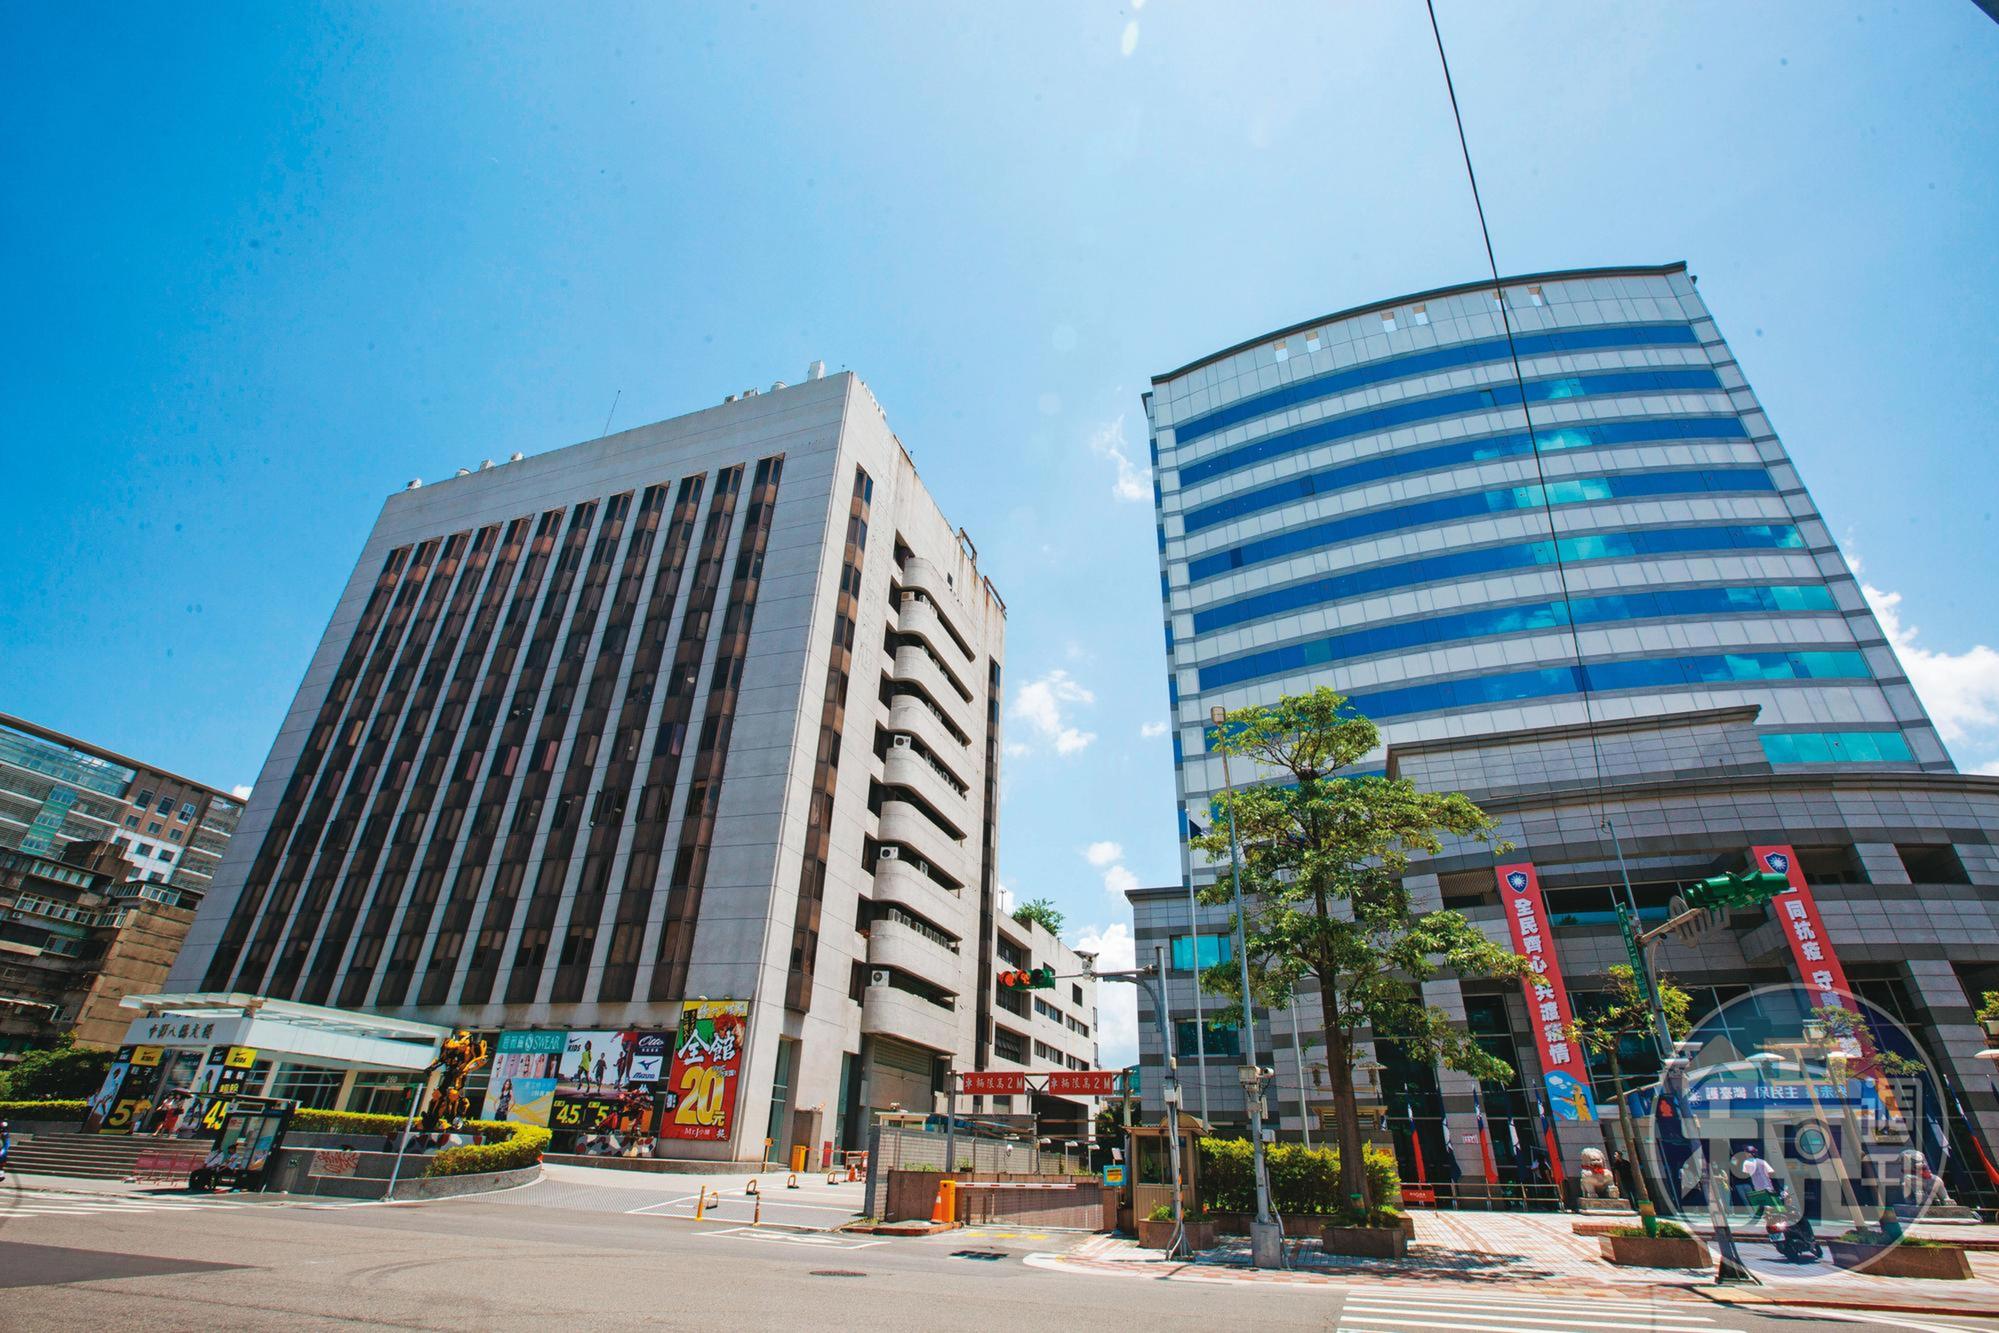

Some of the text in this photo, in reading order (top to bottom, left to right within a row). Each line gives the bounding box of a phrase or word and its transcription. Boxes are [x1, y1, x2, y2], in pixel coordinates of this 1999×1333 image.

[1513, 898, 1548, 974] 全民齊心
[532, 1035, 561, 1051] SWEAR
[567, 1044, 582, 1053] KIDS
[678, 1029, 737, 1066] 全館
[1704, 1086, 1747, 1101] 護臺灣
[1753, 1085, 1799, 1099] 保民主
